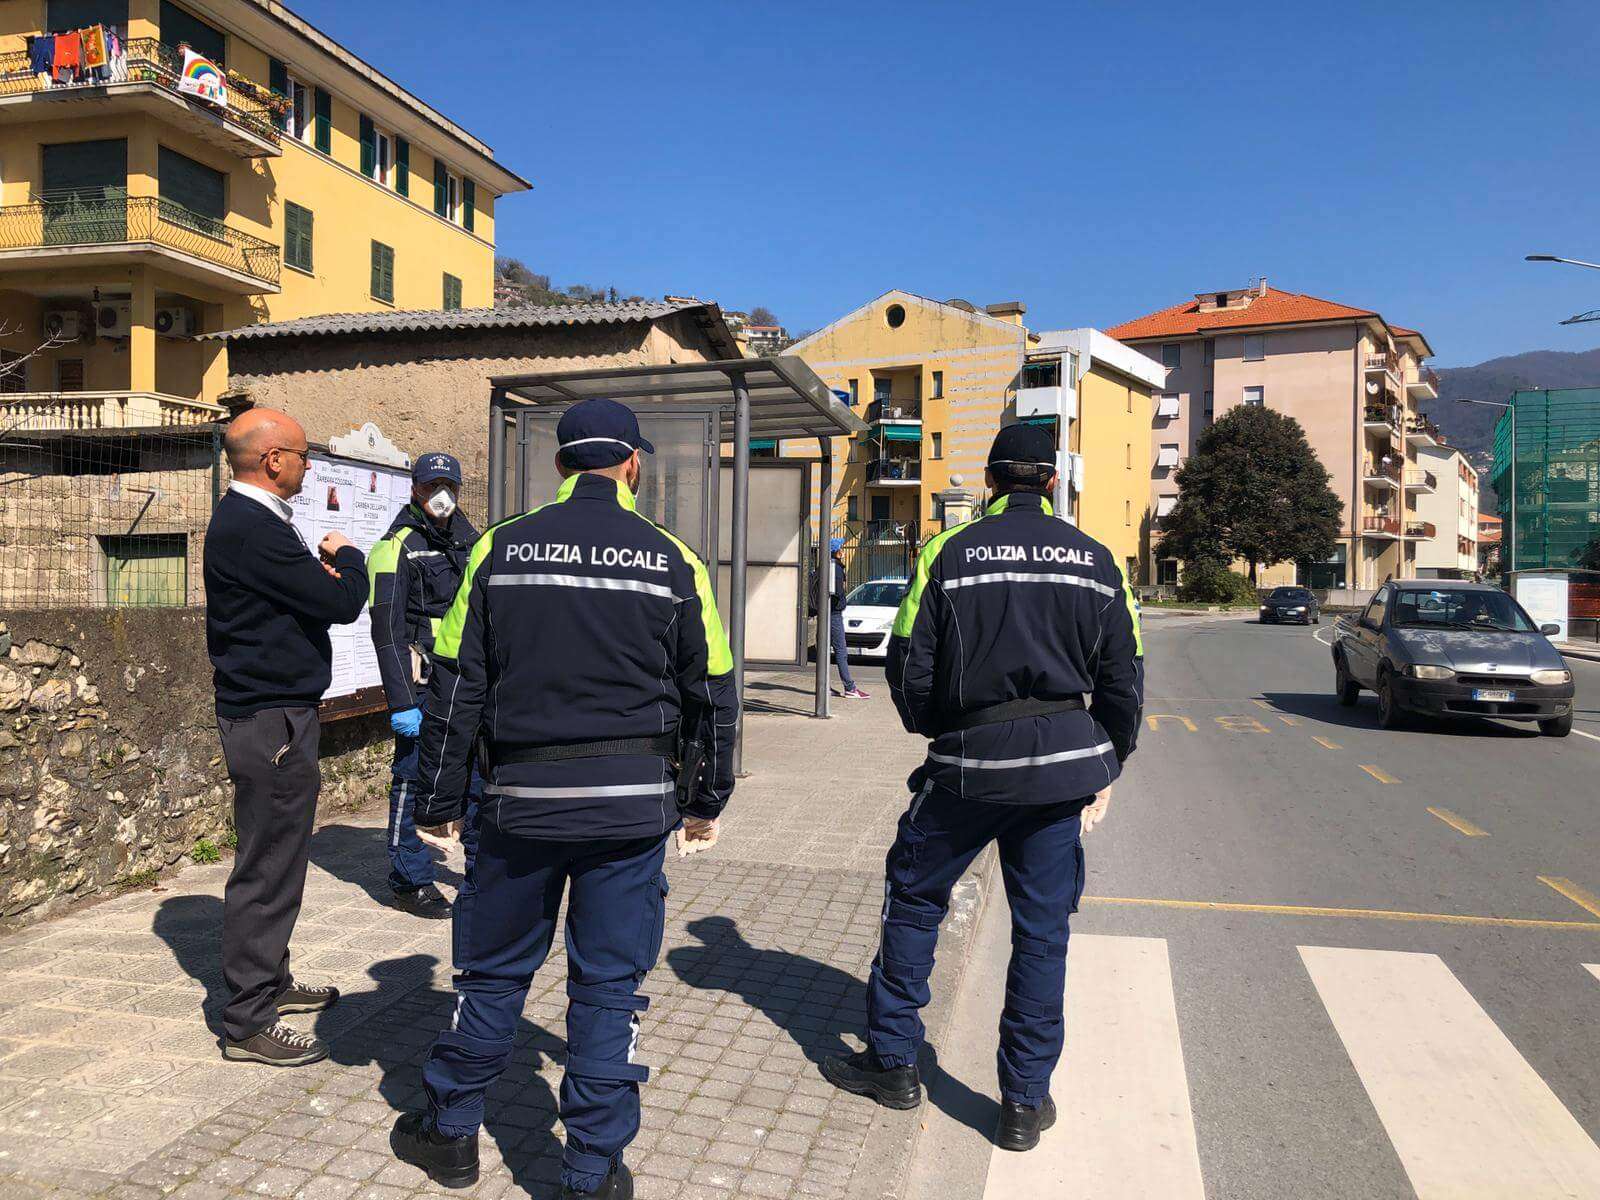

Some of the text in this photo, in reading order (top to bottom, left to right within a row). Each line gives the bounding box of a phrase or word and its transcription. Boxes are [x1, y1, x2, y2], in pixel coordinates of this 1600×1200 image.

[505, 543, 669, 572] POLIZIA LOCALE
[965, 546, 1095, 566] POLIZIA LOCALE
